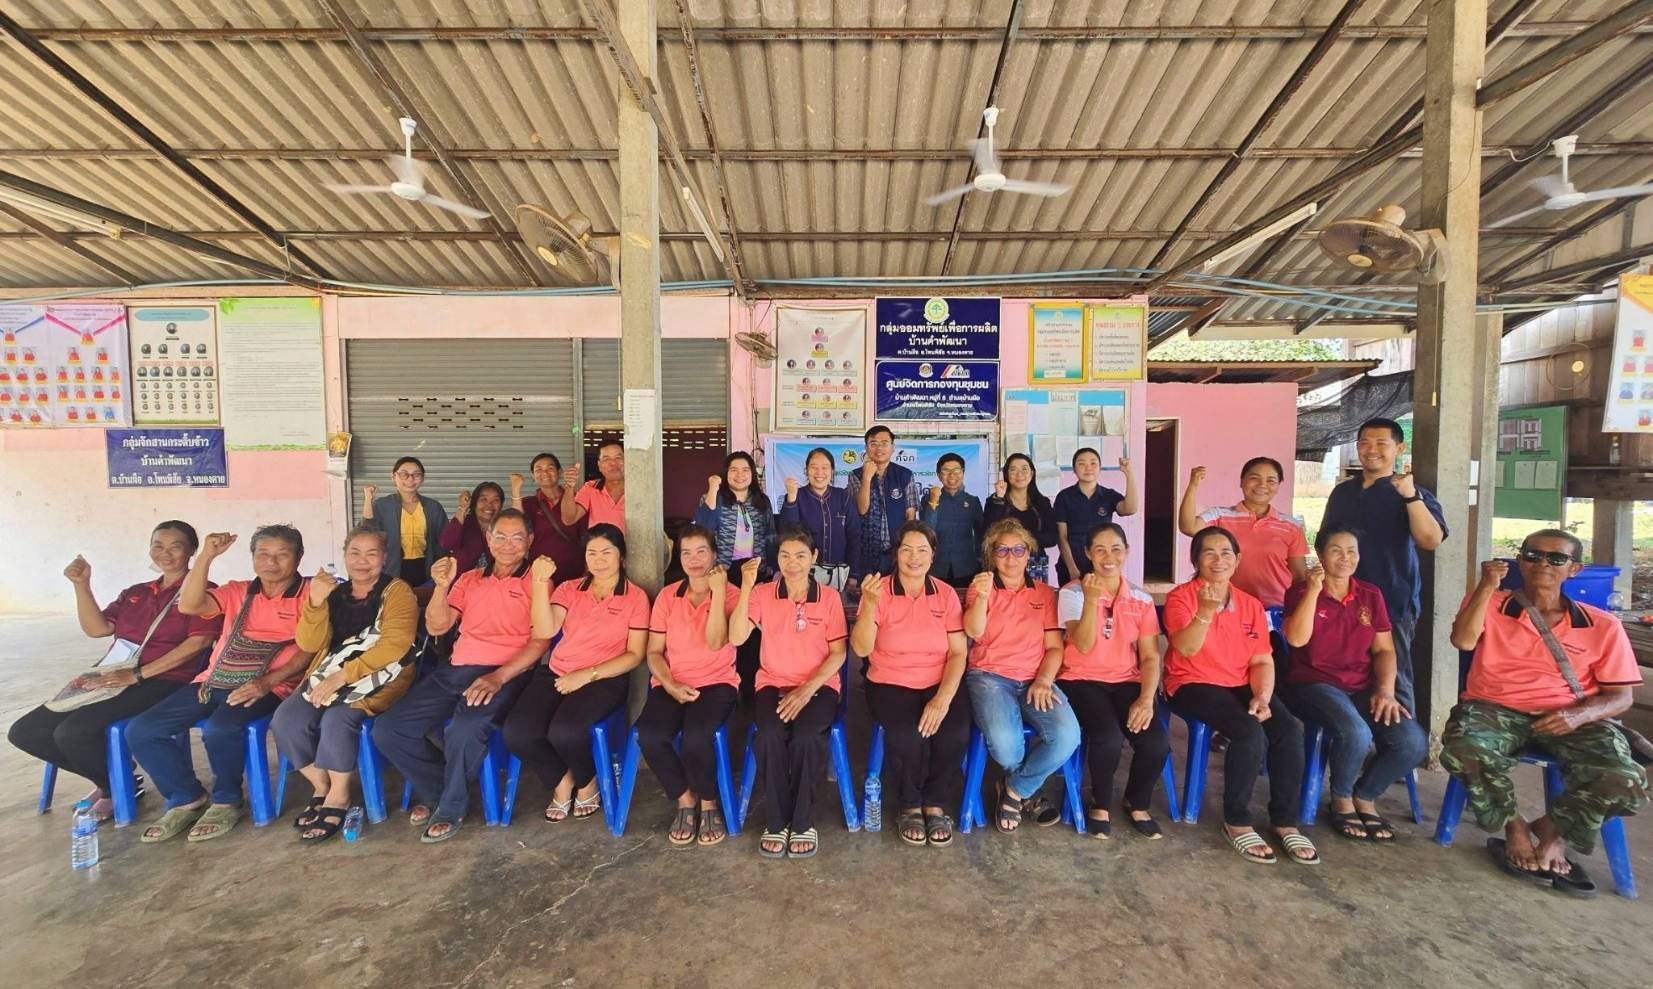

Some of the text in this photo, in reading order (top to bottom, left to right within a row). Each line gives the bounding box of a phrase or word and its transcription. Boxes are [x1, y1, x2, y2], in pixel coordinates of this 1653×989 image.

[880, 321, 997, 335] กลุ่มออมทรัพย์เพื่อการผลิต
[886, 378, 990, 392] ศูนย์จัดการกองทุนชุมชน
